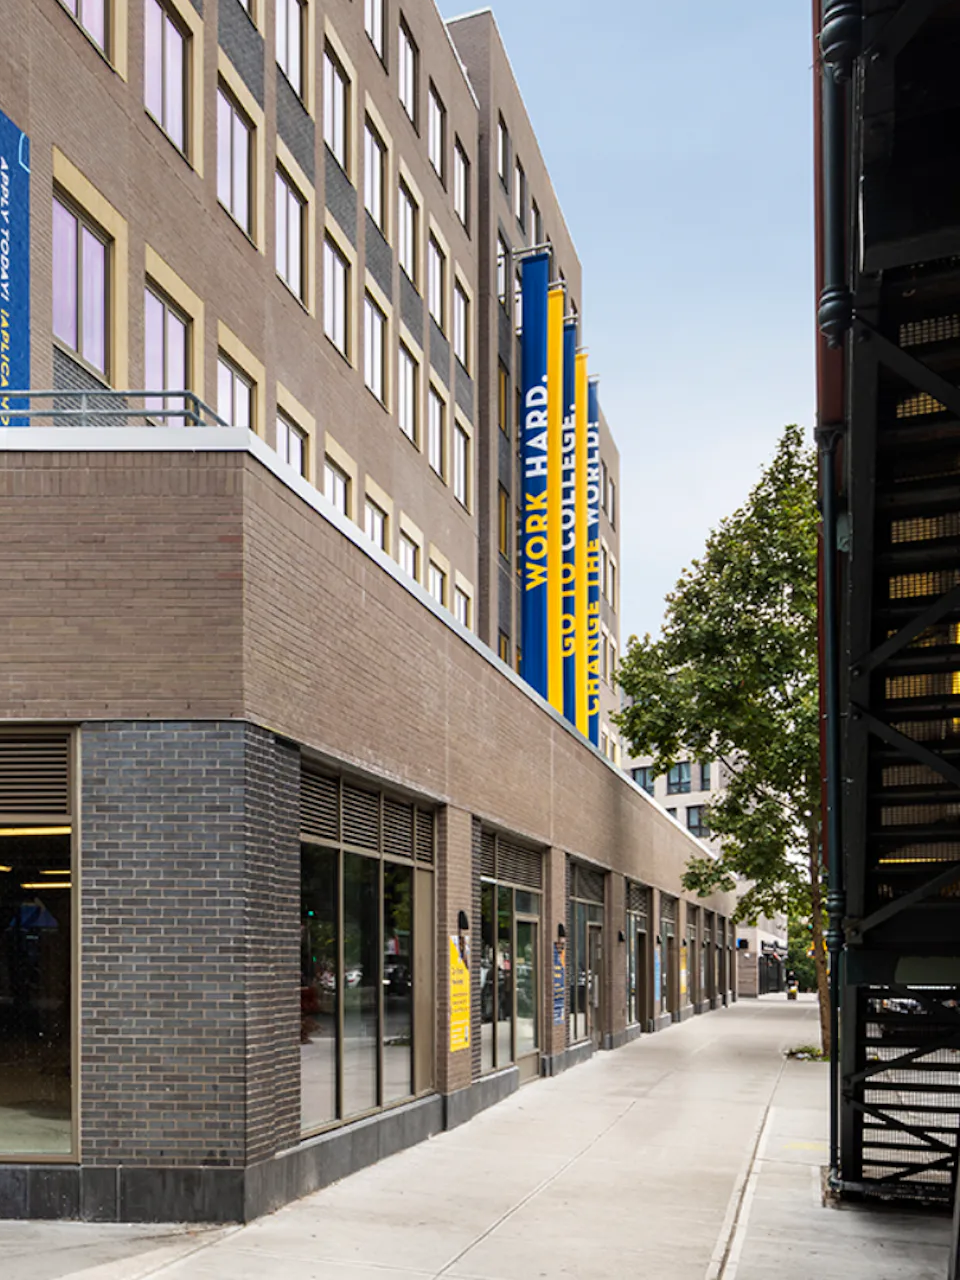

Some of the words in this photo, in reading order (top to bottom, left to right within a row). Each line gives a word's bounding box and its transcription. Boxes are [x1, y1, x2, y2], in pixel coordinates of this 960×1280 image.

[0, 155, 9, 224] APPLY
[0, 228, 10, 301] TODAY!
[525, 374, 548, 478] HARD.
[588, 421, 600, 527] WORLD!
[561, 403, 576, 552] COLLEGE.
[525, 490, 548, 591] WORK
[561, 613, 576, 658] GO
[588, 601, 600, 716] CHANGE
